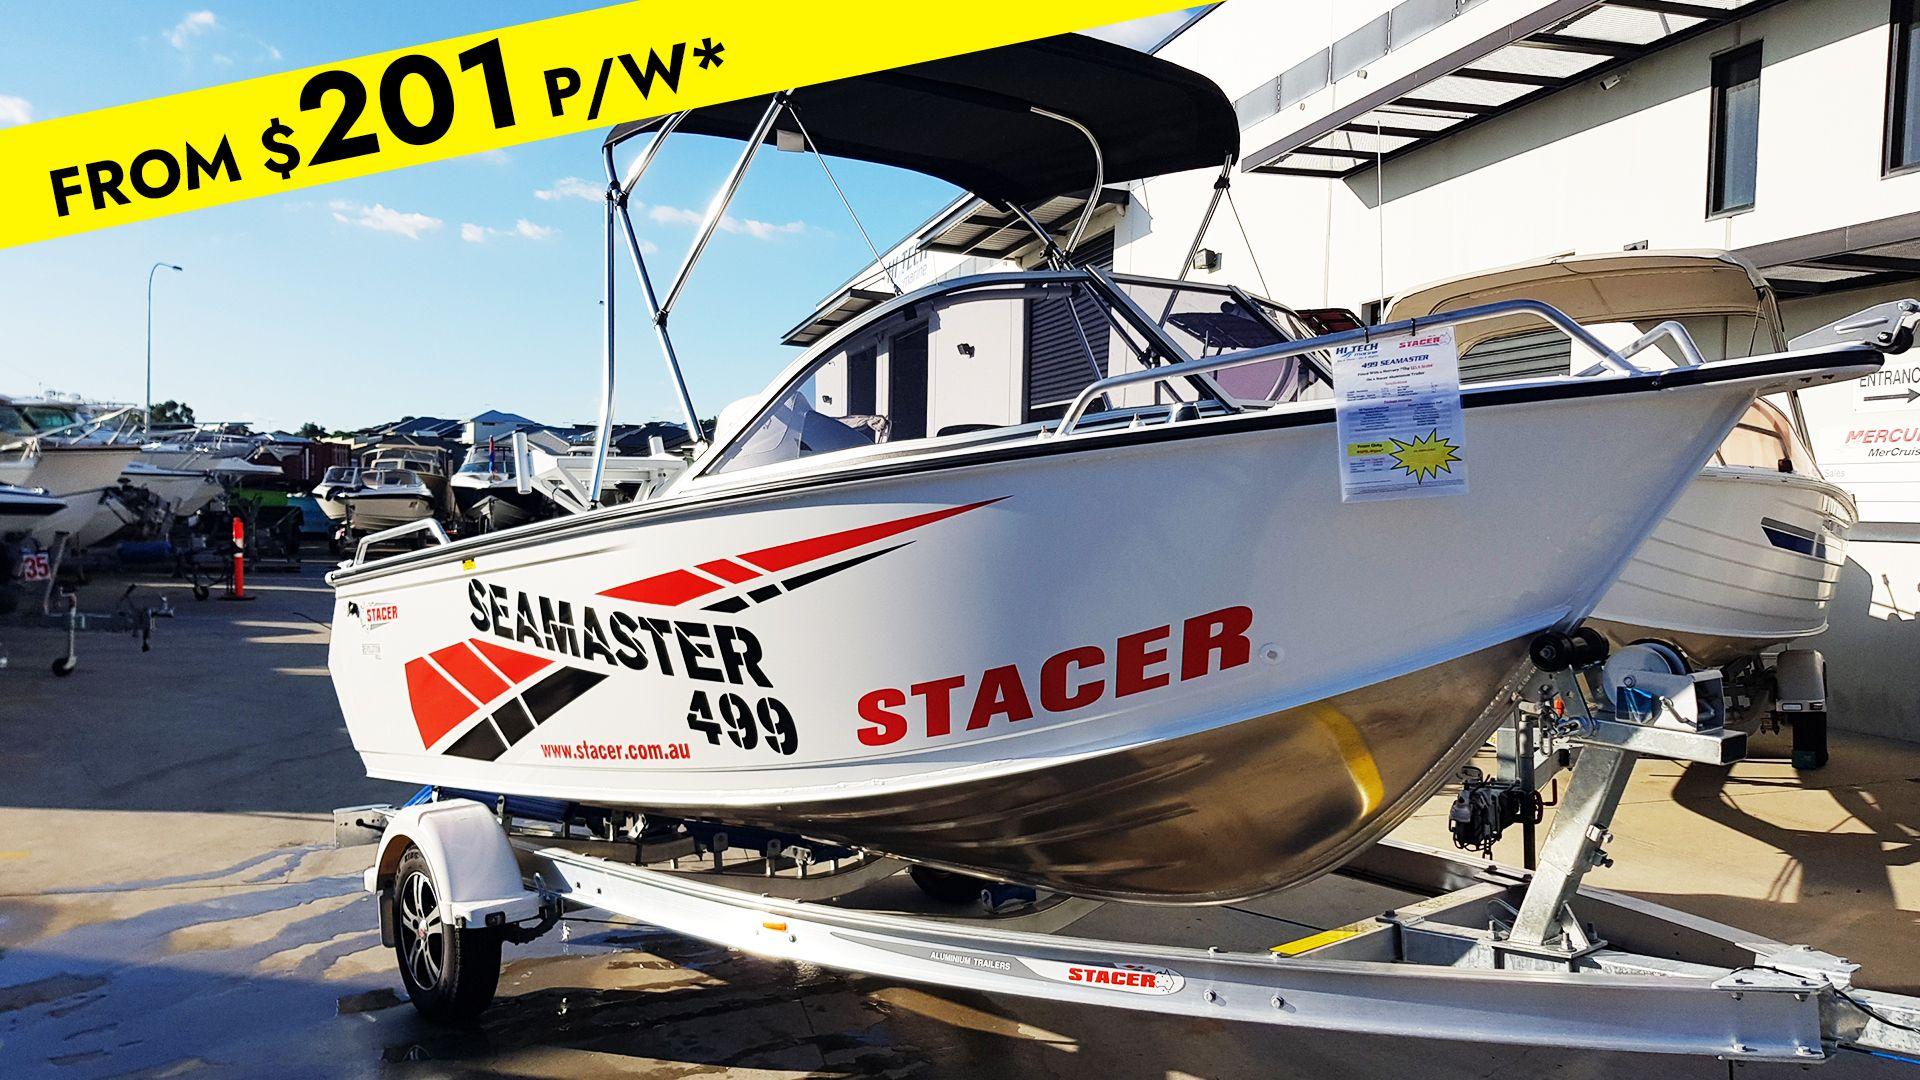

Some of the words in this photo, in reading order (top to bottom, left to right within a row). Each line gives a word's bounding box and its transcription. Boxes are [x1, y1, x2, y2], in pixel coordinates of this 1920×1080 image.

[1351, 343, 1379, 353] TECH
[1398, 337, 1441, 349] STACER
[1361, 360, 1378, 369] 499
[1379, 354, 1430, 367] SEAMASTER
[1845, 428, 1920, 444] MERCU
[25, 557, 49, 578] 35
[366, 606, 398, 622] STACER
[468, 578, 774, 688] SEAMASTER
[857, 605, 1253, 746] STACER
[687, 690, 799, 756] 499
[541, 738, 691, 761] www.stacer.com.au
[930, 951, 971, 965] ALUMINIUM
[973, 957, 1011, 971] TRAILERS
[1068, 967, 1157, 988] STACER
